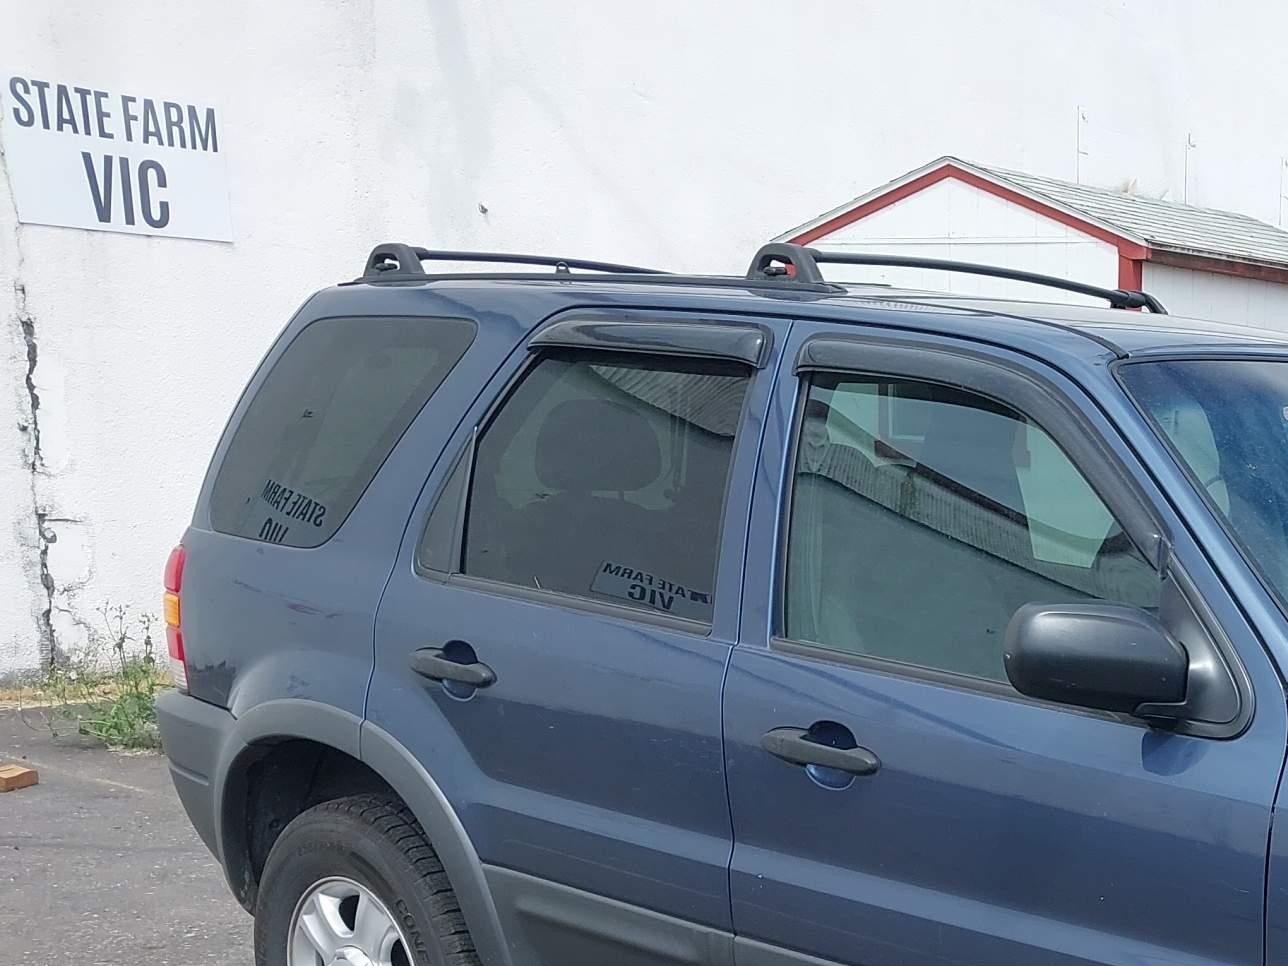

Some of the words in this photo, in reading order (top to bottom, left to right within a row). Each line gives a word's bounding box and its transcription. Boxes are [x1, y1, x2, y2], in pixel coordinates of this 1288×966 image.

[9, 76, 115, 139] STATE
[120, 94, 219, 153] FARM
[80, 150, 170, 229] VIC
